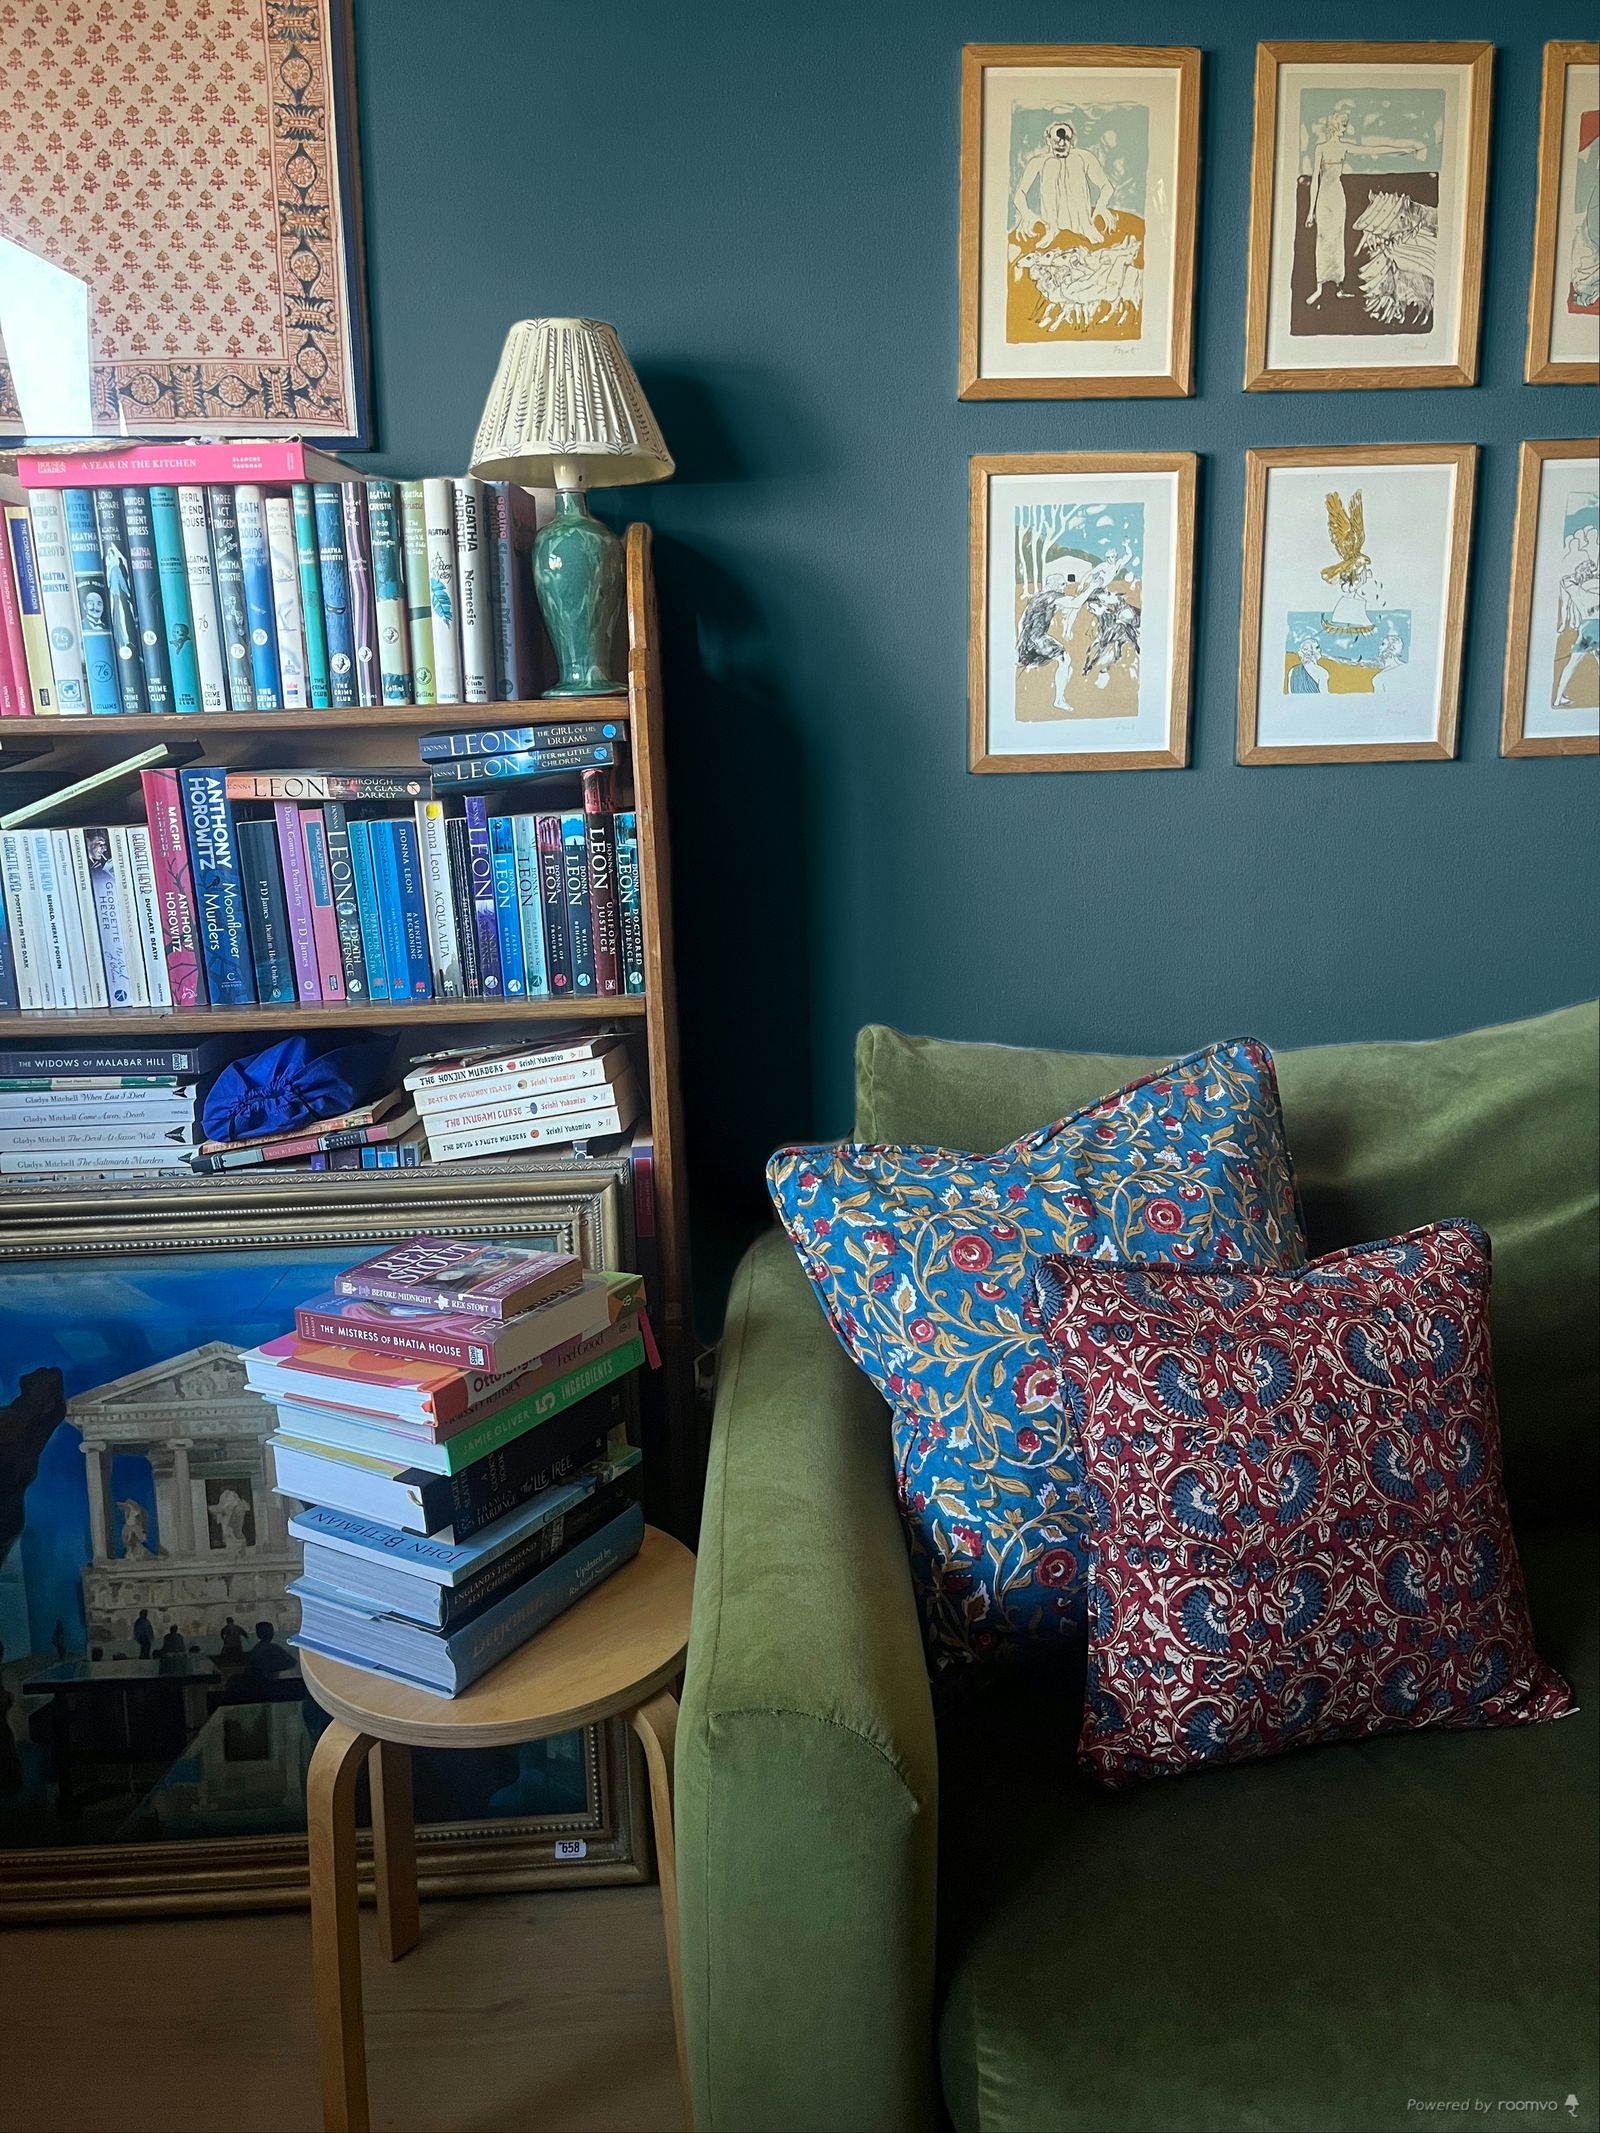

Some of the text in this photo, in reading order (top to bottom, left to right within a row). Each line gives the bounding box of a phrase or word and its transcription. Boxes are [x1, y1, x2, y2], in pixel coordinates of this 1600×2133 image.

[81, 458, 197, 471] A YEAR IN THE KITCHEN
[98, 491, 113, 499] LORD
[213, 494, 231, 504] THREE
[370, 491, 391, 500] AGATHA
[370, 502, 392, 511] CHRISTIE
[102, 511, 115, 519] DIES
[217, 507, 229, 516] ACT
[454, 488, 467, 553] CHRISTIE
[465, 494, 479, 552] AGATHA
[496, 496, 507, 539] agatha
[20, 524, 28, 536] THE
[71, 532, 98, 541] AGATHA
[428, 529, 451, 537] AGATHA
[22, 536, 31, 564] CORNISH
[72, 543, 100, 552] CHRISTIE
[26, 564, 34, 585] COAST
[30, 585, 38, 610] MURDER
[464, 569, 477, 626] Nemesis
[148, 685, 167, 694] CRIME
[206, 683, 217, 691] THE
[234, 677, 248, 685] THE
[385, 684, 405, 692] Collins
[18, 686, 26, 709] VINTAGE
[150, 694, 166, 702] CLUB
[233, 695, 252, 703] CLUB
[449, 730, 521, 756] LEON
[547, 736, 588, 746] DREAMS
[456, 758, 520, 781] LEON
[541, 757, 581, 768] CHILDREN
[253, 778, 325, 798] LEON
[356, 791, 396, 799] DARKLY
[168, 806, 181, 851] MAGPIE
[188, 777, 216, 870] HOROWITZ
[206, 777, 233, 869] ANTHONY
[314, 828, 329, 900] MURDER AFTER CHRISTMAS
[326, 830, 354, 901] LEON
[399, 828, 414, 894] DONNA LEON
[430, 853, 443, 881] Leon
[468, 827, 493, 899] LEON
[589, 827, 608, 890] LEON
[606, 842, 614, 874] DONNA
[284, 806, 310, 968] Death Comes to Pemberley P. D. James
[495, 858, 511, 909] LEON
[517, 857, 534, 907] LEON
[544, 854, 558, 904] LEON
[565, 855, 582, 906] LEON
[580, 865, 588, 895] DONNA
[619, 851, 634, 904] LEON
[632, 863, 640, 893] DONNA
[105, 881, 120, 943] GEORGETTE
[132, 833, 159, 961] GEORGETTE HEYER DUPLICATE DEATH
[434, 889, 447, 929] ACQUA
[99, 896, 111, 931] HEYER
[165, 891, 182, 953] HOROWITZ
[178, 892, 194, 950] ANTHONY
[203, 893, 224, 951] Murders
[222, 882, 242, 959] Moonflower
[597, 905, 607, 953] JUSTICE
[606, 901, 616, 955] UNIFORM
[350, 929, 361, 963] DEATH
[406, 912, 417, 960] RECKONING
[414, 920, 424, 960] VENETIAN
[440, 932, 450, 959] ALTA
[574, 920, 582, 965] BEHAVIOUR
[623, 911, 634, 963] EVIDENCE
[632, 908, 642, 965] DOCTORED
[34, 1059, 80, 1068] WIDOWS
[95, 1058, 143, 1067] MALABAR
[146, 1058, 166, 1066] HILL
[420, 1053, 564, 1086] THE HONJIN MURDERS Seishi Yokomizo
[445, 1096, 586, 1128] THE INUGAMI CURSE Seishi Yokomizo
[17, 1156, 164, 1170] Gladys Mitchell The Saltmarsh Murders
[368, 1244, 444, 1271] REX
[387, 1243, 480, 1283] STOUT
[371, 1289, 432, 1304] BEFORE MIDNIGHT
[451, 1300, 489, 1313] REX STOUT
[320, 1324, 334, 1334] THE
[338, 1325, 379, 1342] MISTRESS
[380, 1336, 391, 1344] OF
[393, 1337, 426, 1351] BHATIA
[428, 1343, 461, 1357] HOUSE
[577, 1335, 604, 1355] Good
[560, 1359, 613, 1402] INGREDIENTS
[534, 1391, 556, 1415] 5
[462, 1429, 492, 1456] JAMIE
[493, 1409, 530, 1437] OLIVER
[478, 1495, 517, 1526] HARDINGE
[310, 1512, 465, 1564] JOHN BETJEMAN
[453, 1570, 496, 1605] ENGLAND'S
[498, 1541, 537, 1572] THOUSAND
[575, 1554, 603, 1578] Updated
[468, 1562, 526, 1606] BEST CHURCHES
